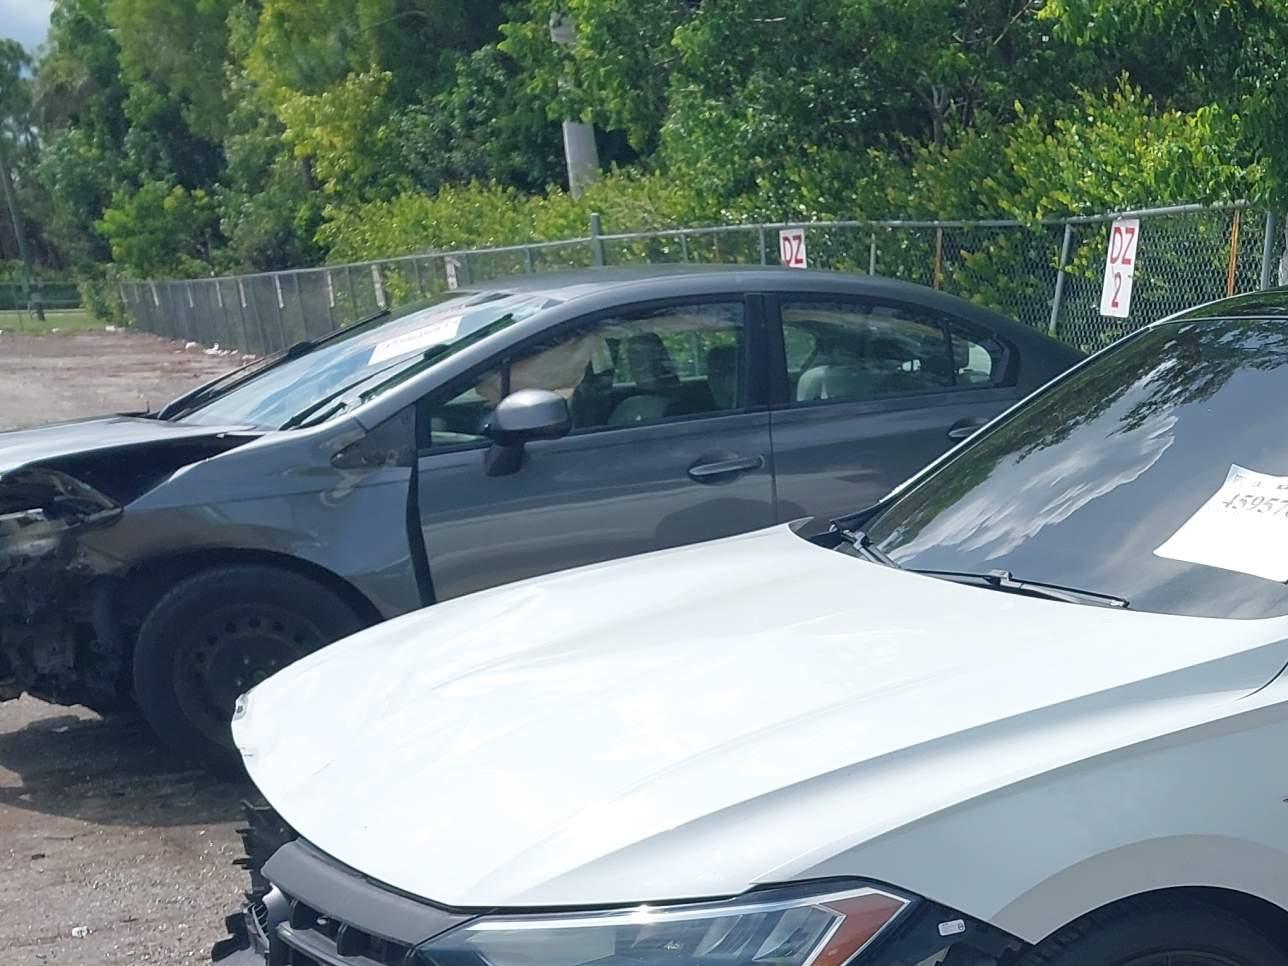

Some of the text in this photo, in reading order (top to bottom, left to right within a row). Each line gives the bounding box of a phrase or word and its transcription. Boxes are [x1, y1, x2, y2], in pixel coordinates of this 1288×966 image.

[782, 233, 804, 266] DZ
[1110, 226, 1136, 266] DZ
[1111, 271, 1122, 308] 2
